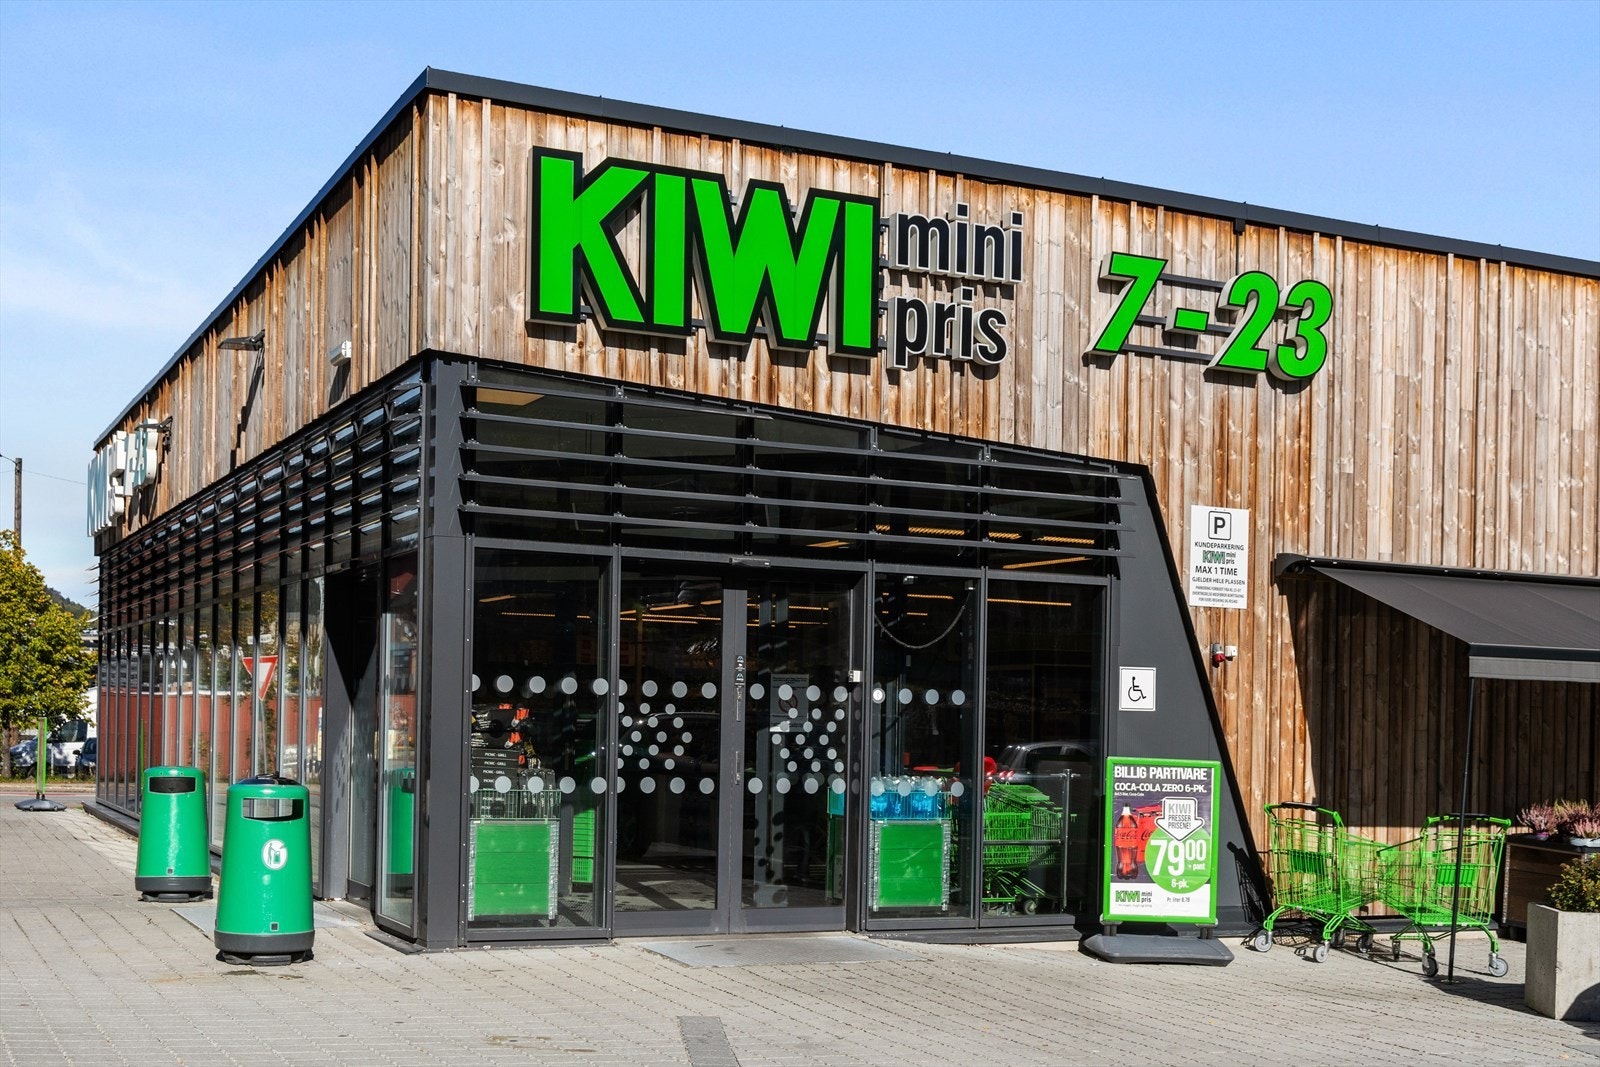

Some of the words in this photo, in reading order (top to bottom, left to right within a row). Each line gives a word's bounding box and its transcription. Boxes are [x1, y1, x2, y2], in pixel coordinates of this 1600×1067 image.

[900, 203, 1023, 283] mini
[532, 147, 879, 357] KIWI
[1093, 252, 1333, 378] 7-23
[892, 288, 1007, 368] pris
[1214, 517, 1226, 534] P
[1194, 542, 1244, 551] KUNDEPARKERING
[1202, 550, 1226, 564] KIWI
[1195, 566, 1212, 574] MAX
[1220, 568, 1237, 576] TIME
[1114, 766, 1146, 778] BILLIG
[1150, 767, 1207, 780] PARTIVARE
[1115, 783, 1160, 792] COCA-COLA
[1162, 784, 1184, 792] ZERO
[1185, 784, 1207, 793] 6-PK.
[1168, 803, 1191, 814] KIWI
[1193, 863, 1205, 871] pant
[1172, 879, 1189, 889] 6-pk.
[1116, 890, 1140, 902] KIWI
